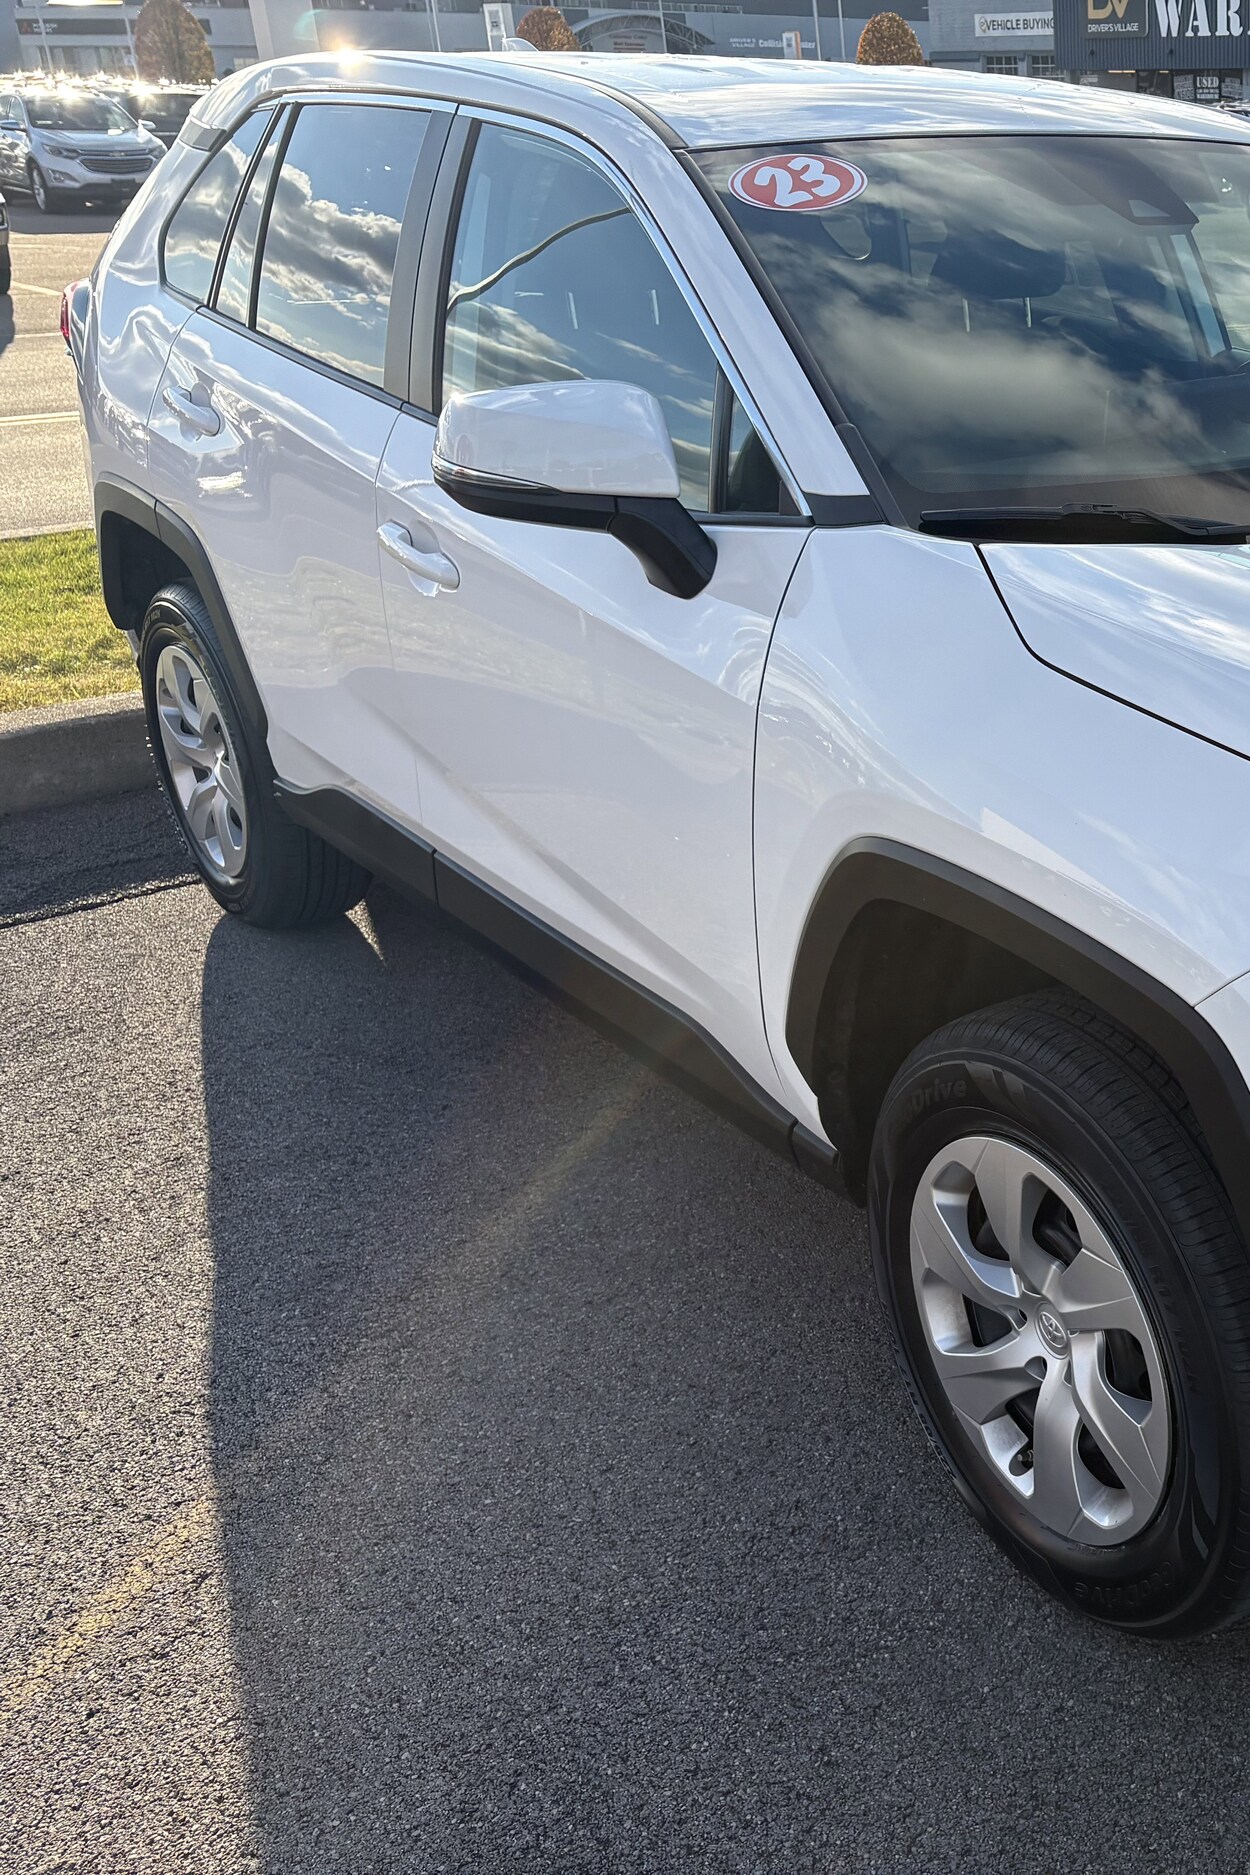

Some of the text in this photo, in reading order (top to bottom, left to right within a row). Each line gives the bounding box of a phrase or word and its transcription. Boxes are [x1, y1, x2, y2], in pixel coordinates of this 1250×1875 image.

[986, 20, 1021, 31] VEHICLE
[1114, 22, 1139, 32] VILLAGE
[1196, 76, 1219, 88] USED
[754, 157, 840, 207] 23
